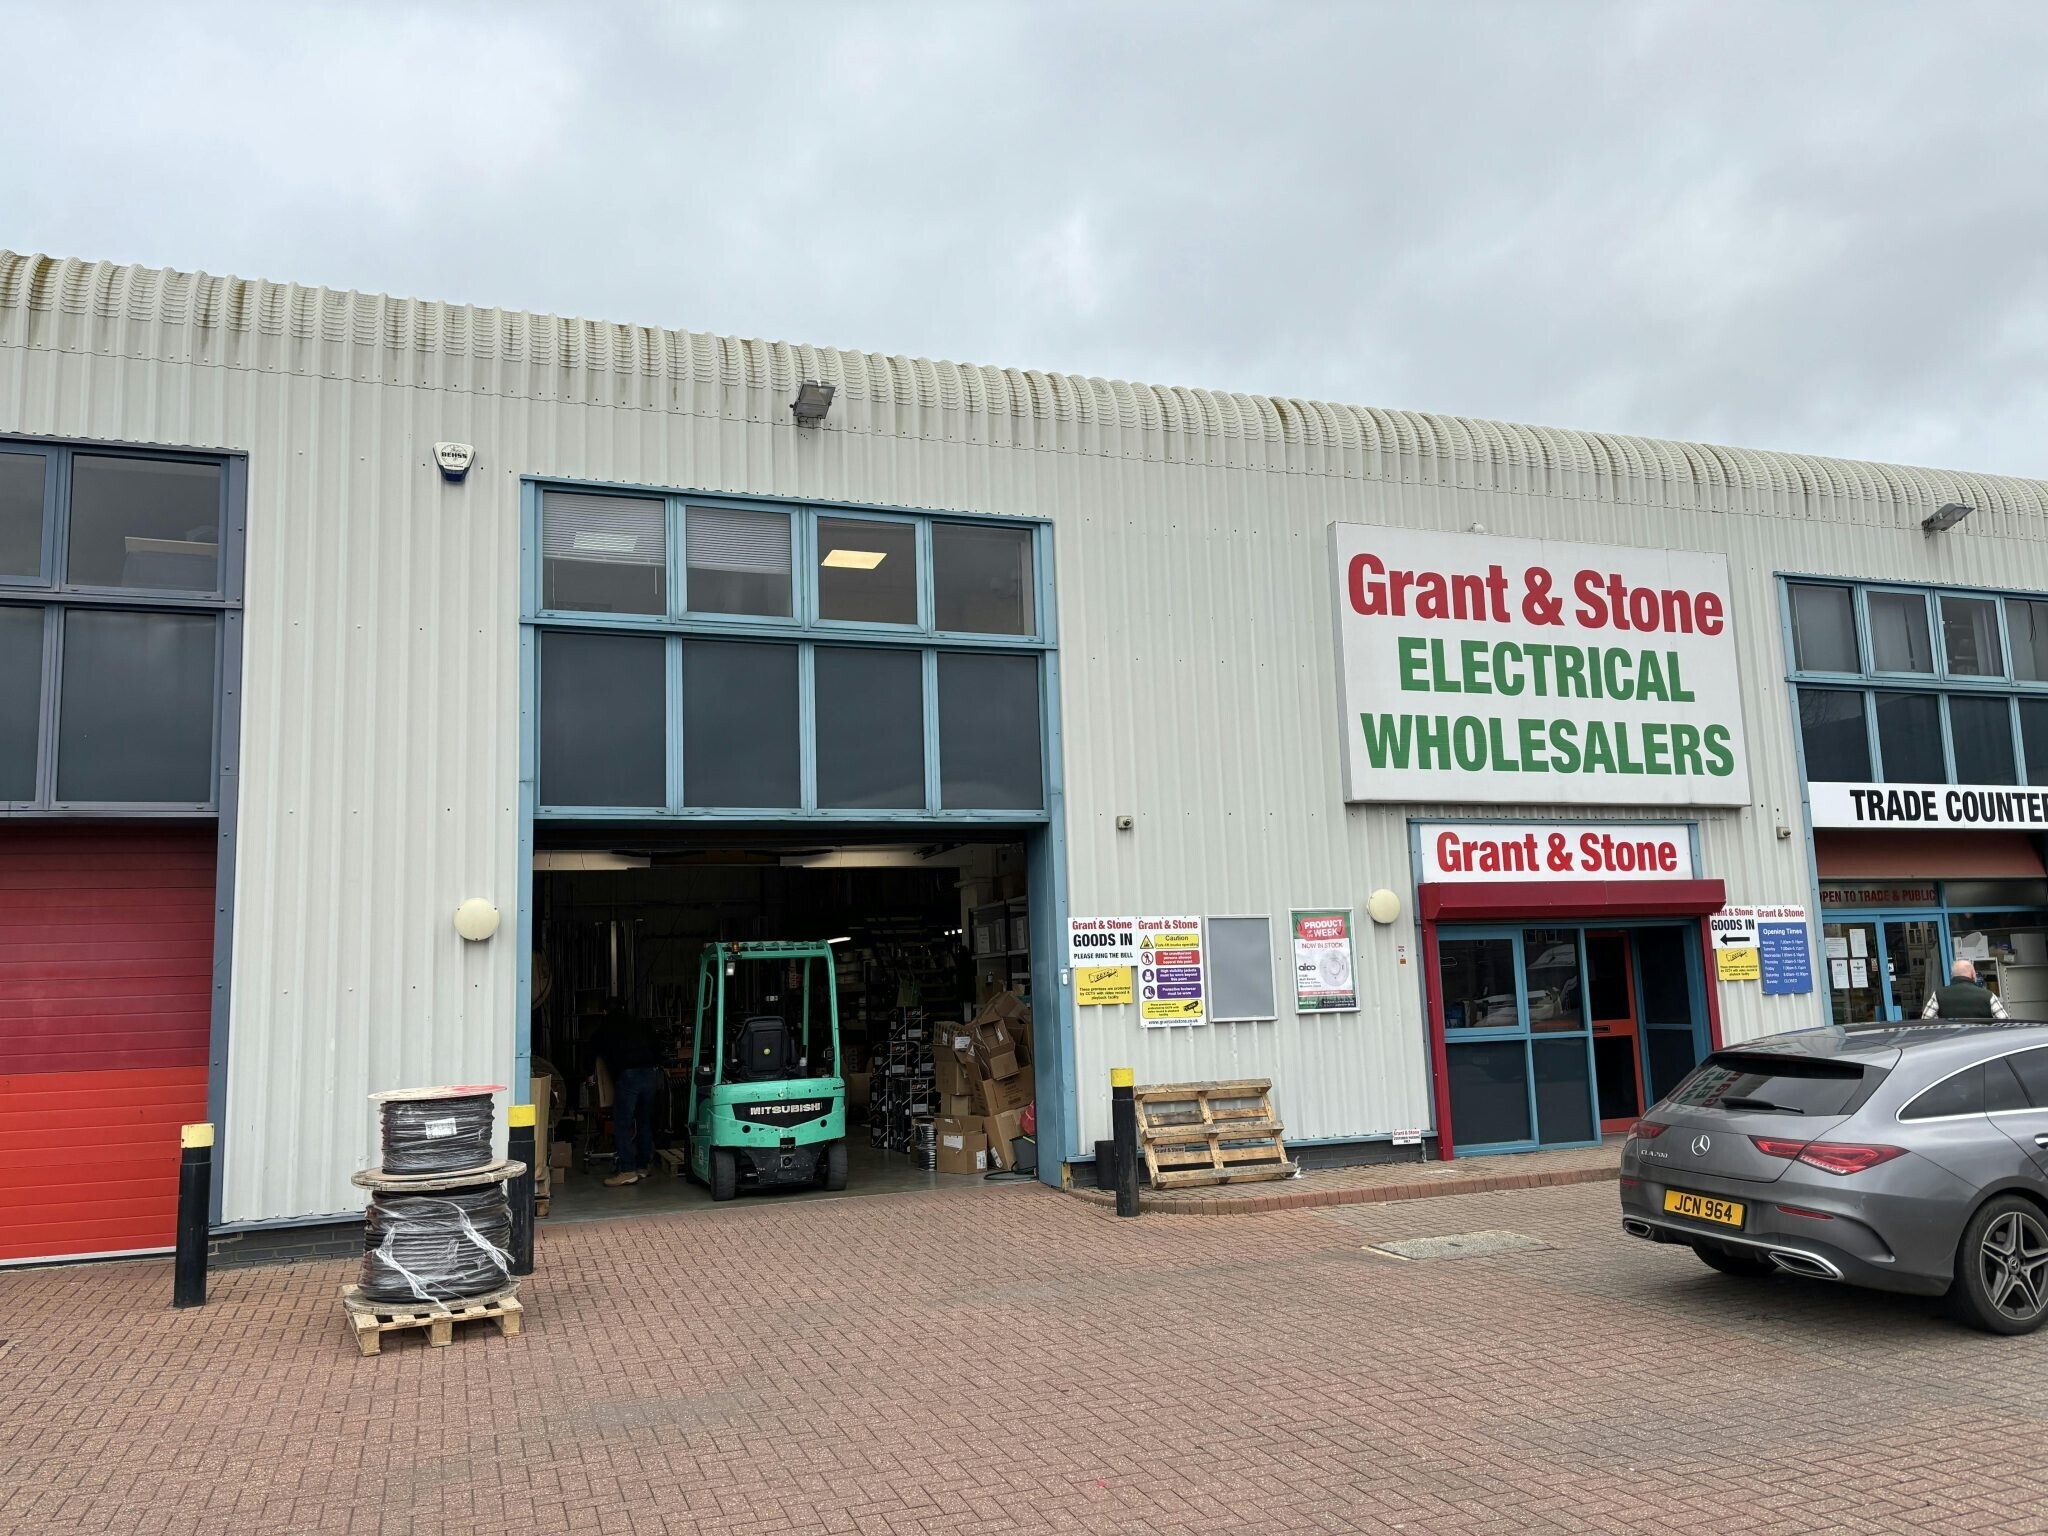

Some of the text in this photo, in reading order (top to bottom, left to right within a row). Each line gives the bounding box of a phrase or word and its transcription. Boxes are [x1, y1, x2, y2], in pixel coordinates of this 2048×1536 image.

[1348, 553, 1723, 636] Grant & Stone
[1398, 636, 1695, 702] ELECTRICAL
[1360, 713, 1735, 777] WHOLESALERS
[1849, 789, 1938, 821] TRADE
[1437, 831, 1677, 873] Grant & Stone
[1820, 889, 1935, 902] PEN TO TRADE & PUBLIC
[1729, 908, 1734, 916] &
[1735, 908, 1753, 916] Stone
[1758, 909, 1804, 917] Grant & Stone
[1072, 920, 1132, 930] Grant & Stone
[1138, 920, 1198, 930] Grant & Stone
[1304, 920, 1342, 929] PRODUCT
[1711, 919, 1755, 930] GOODS IN
[1314, 928, 1338, 937] WEEK
[1073, 933, 1133, 947] GOODS IN
[1074, 952, 1094, 960] PLEASE
[750, 1102, 820, 1115] MITSUBISHI
[1674, 1195, 1733, 1222] JCN 964
